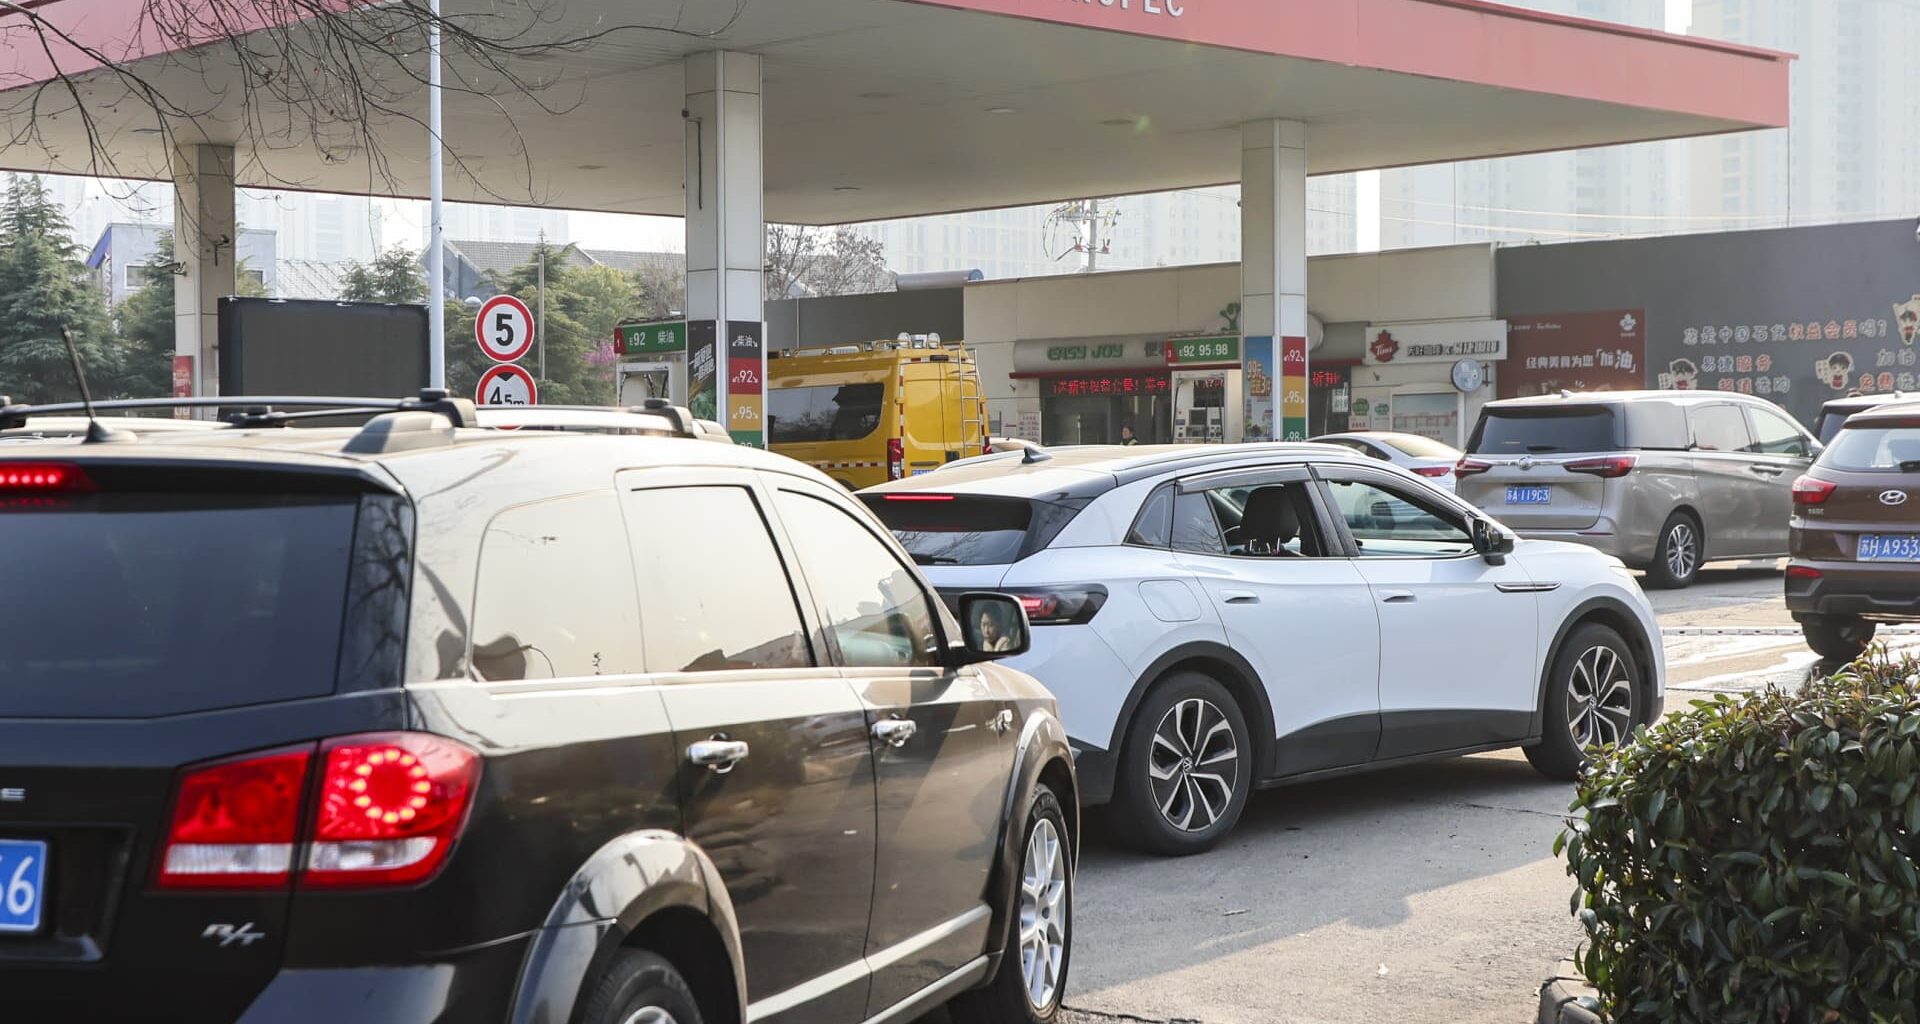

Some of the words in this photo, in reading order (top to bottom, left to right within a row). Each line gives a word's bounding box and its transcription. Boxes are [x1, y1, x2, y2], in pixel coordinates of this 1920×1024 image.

[495, 313, 514, 346] 5
[658, 329, 675, 344] 柴油
[737, 335, 752, 347] 柴油
[1199, 344, 1211, 356] 95
[1288, 390, 1300, 403] 95
[739, 406, 753, 419] 95
[0, 855, 35, 916] 6
